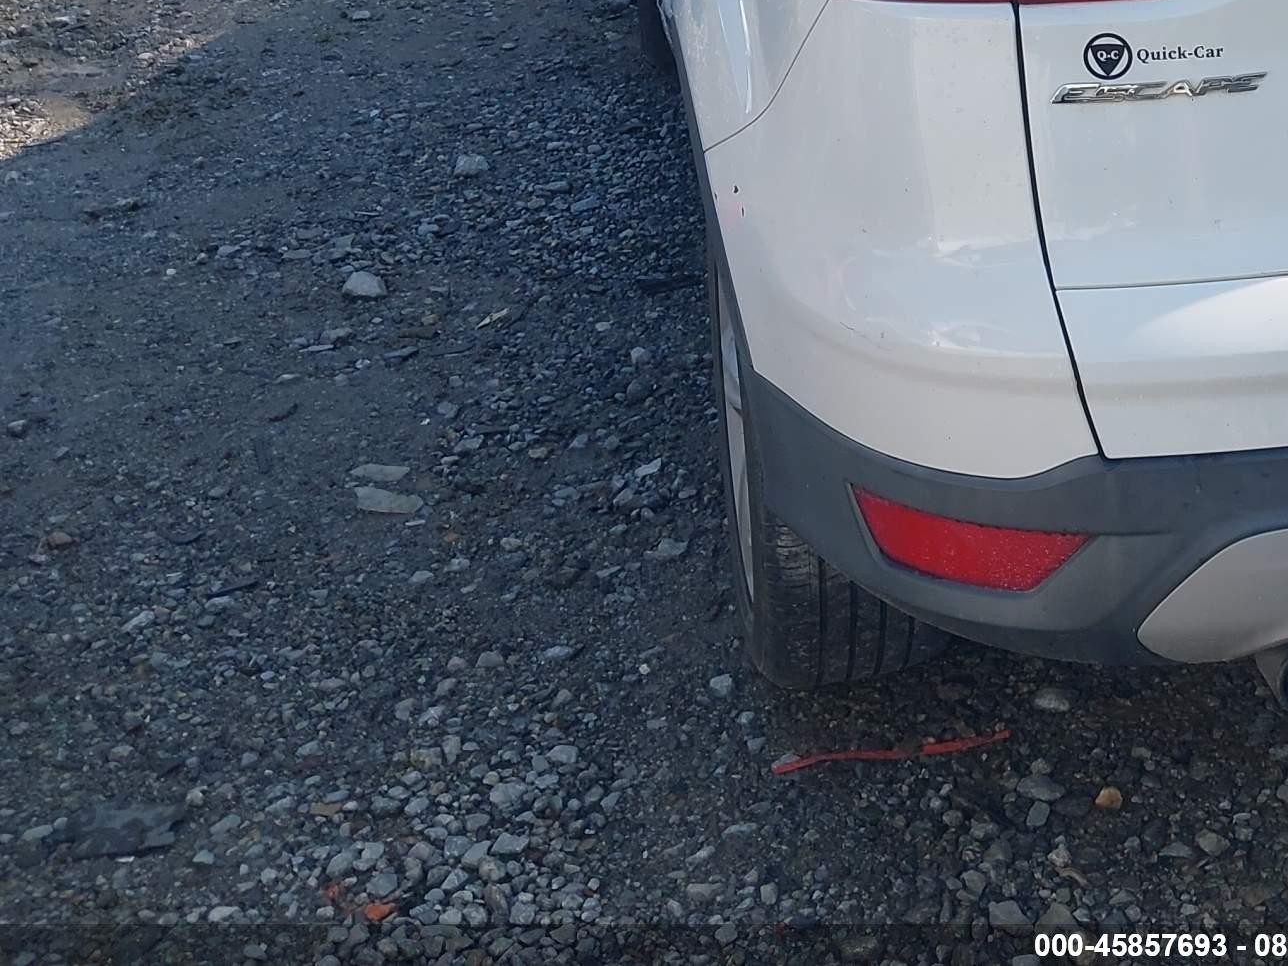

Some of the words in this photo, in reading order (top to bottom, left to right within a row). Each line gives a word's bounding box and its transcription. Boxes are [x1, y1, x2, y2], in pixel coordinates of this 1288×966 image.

[1096, 49, 1120, 62] Q-C
[1136, 45, 1224, 64] Quick-Car
[1050, 71, 1268, 105] ESCAPE
